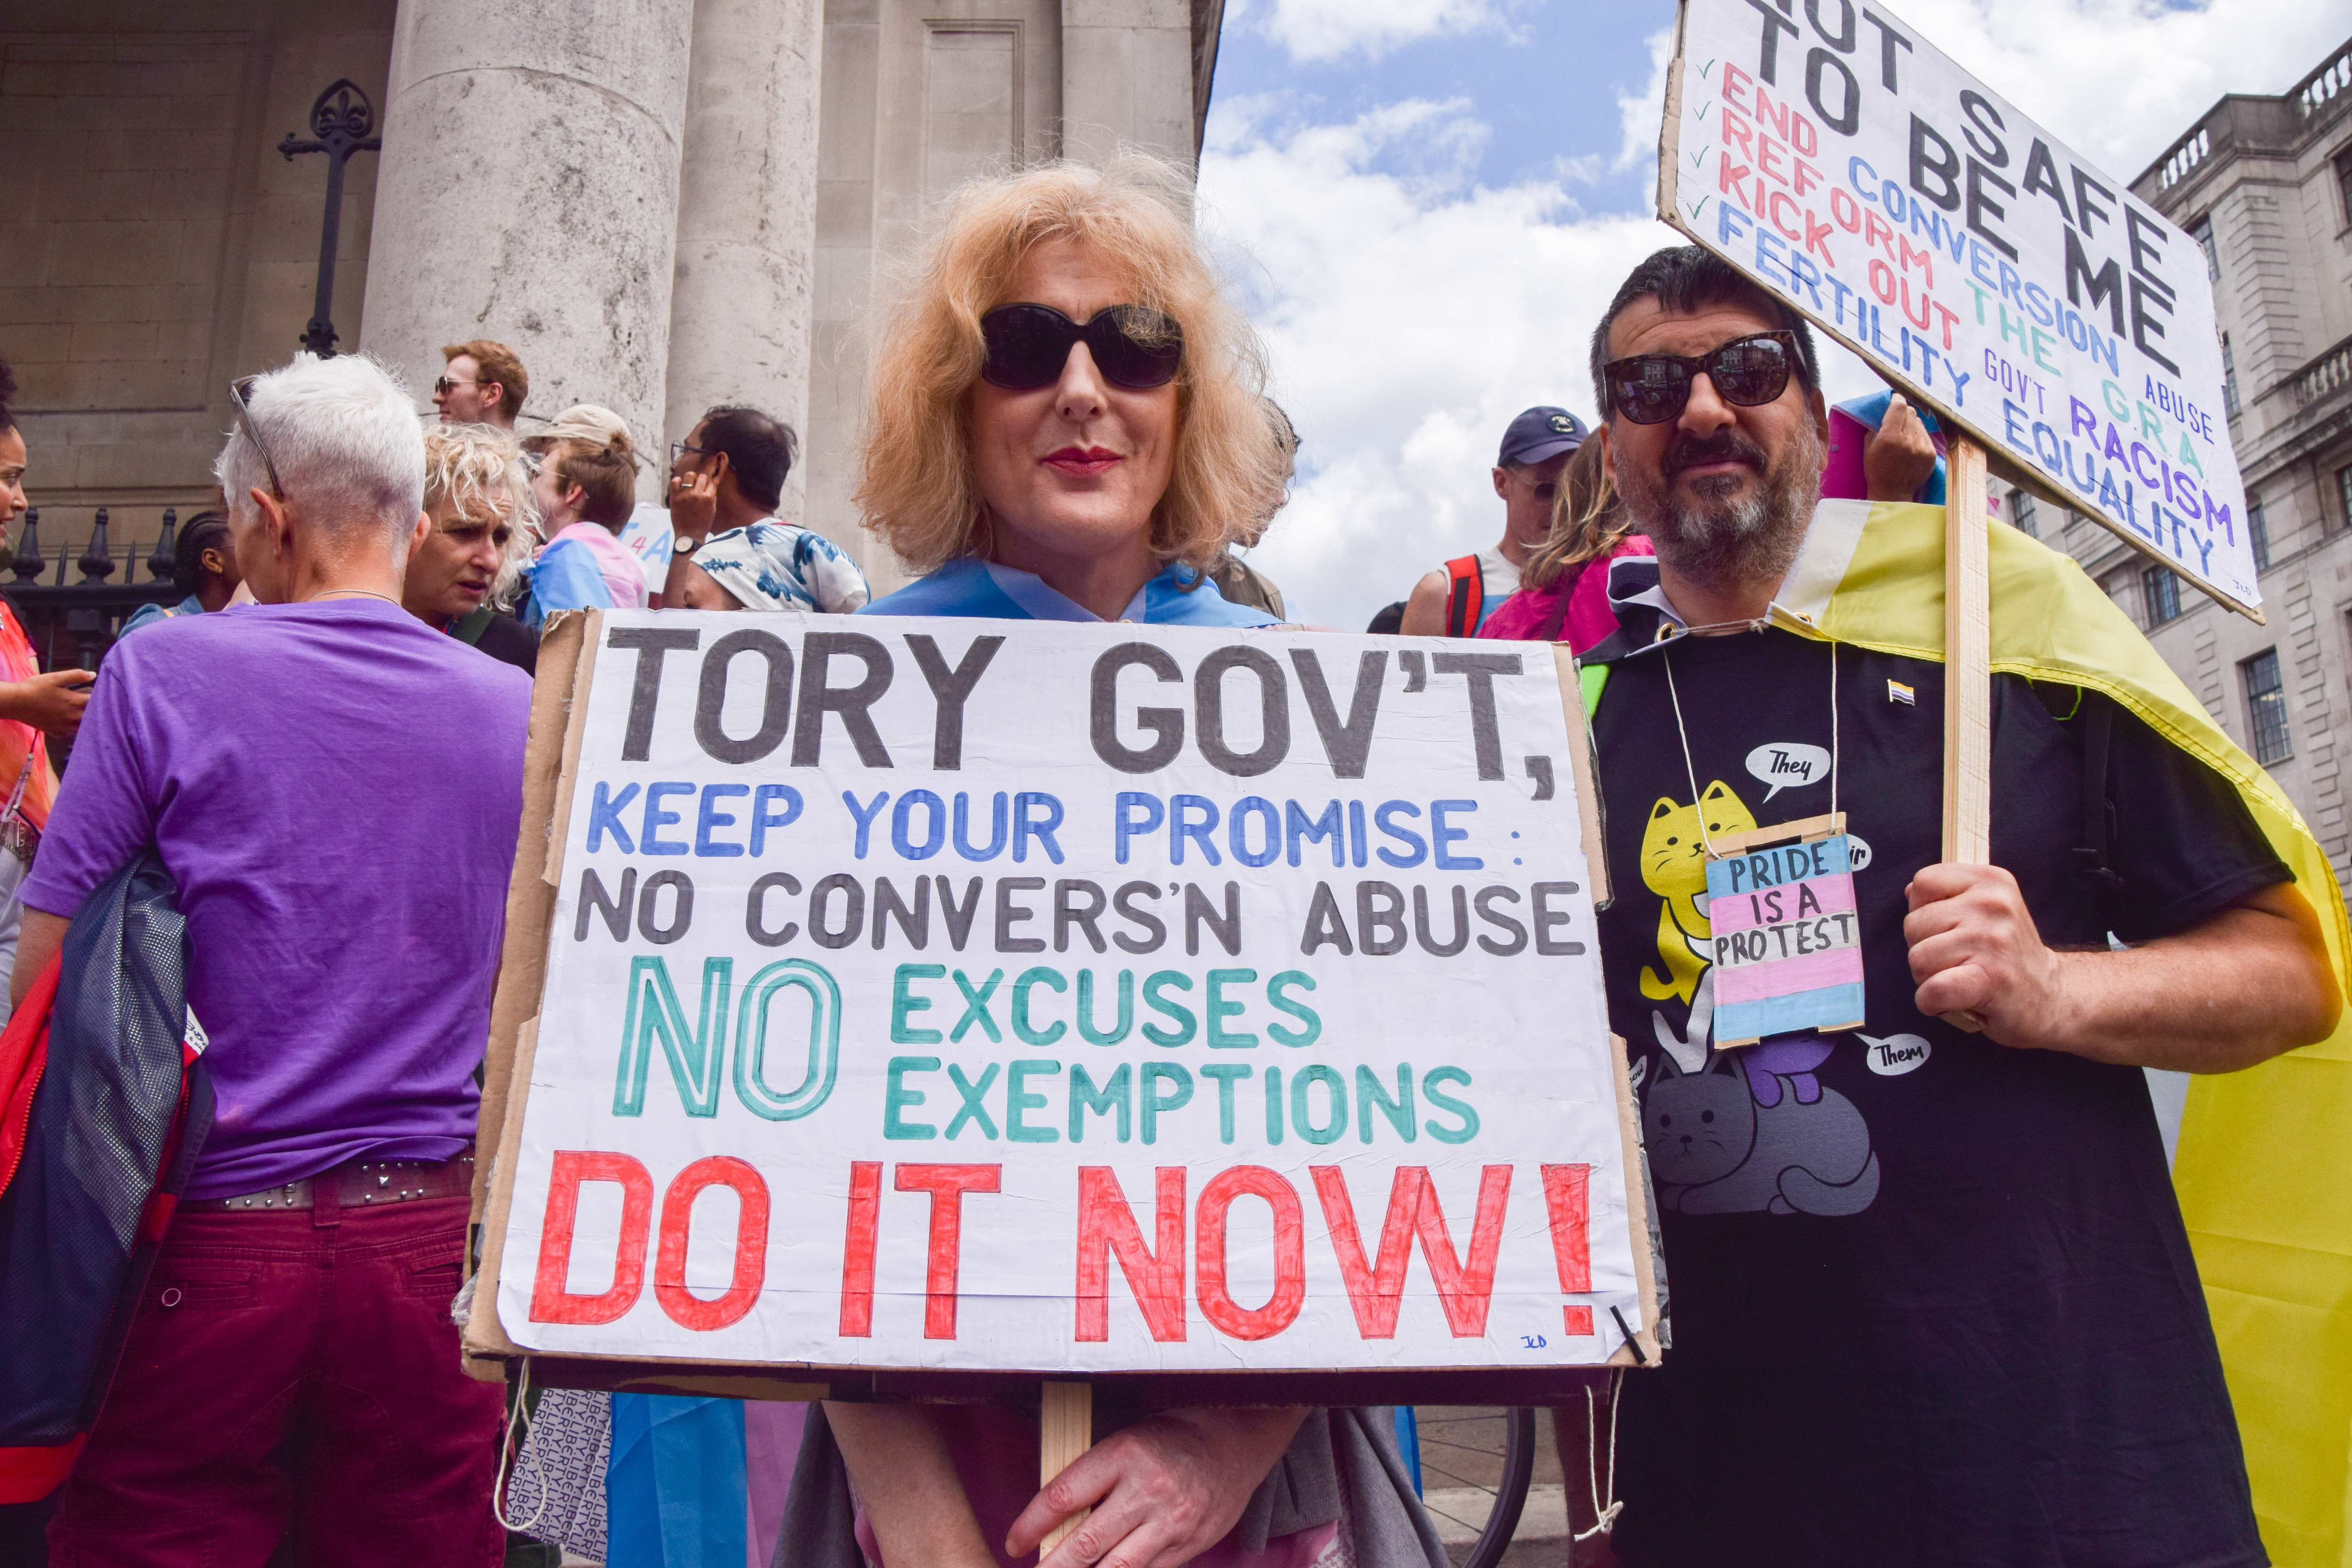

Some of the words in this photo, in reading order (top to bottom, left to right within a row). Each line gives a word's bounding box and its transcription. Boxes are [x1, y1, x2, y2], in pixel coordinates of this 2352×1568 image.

[1747, 0, 1860, 136] TO
[1909, 111, 2018, 264] BE
[2063, 223, 2182, 379] ME
[1775, 0, 1913, 96] OT
[1959, 89, 2177, 302] SAFE
[1722, 107, 1933, 290] REFORM
[1965, 278, 2063, 377] THE
[1722, 62, 1818, 158] END
[1848, 156, 2119, 377] CONVERSION
[2145, 374, 2215, 446] ABUSE
[1717, 200, 1971, 408] FERTILITY
[2002, 398, 2214, 576] EQUALITY
[1719, 151, 1836, 269] KICK
[1868, 259, 1960, 351] OUT
[1984, 348, 2046, 414] GOV'T
[2070, 395, 2234, 547] RACISM
[607, 627, 1007, 771] TORY
[1090, 641, 1554, 801] GOV'T,
[1769, 749, 1812, 780] They
[587, 781, 804, 858] KEEP
[842, 788, 1065, 865] YOUR
[1729, 841, 1829, 893] PRIDE
[1750, 891, 1782, 926] IS
[1798, 883, 1822, 915] A
[574, 867, 694, 945] NO
[746, 872, 1242, 957] CONVERS'N
[1300, 881, 1586, 957] ABUSE
[1716, 913, 1855, 966] PROTEST
[612, 955, 842, 1122] NO
[890, 963, 1322, 1049] EXCUSES
[883, 1056, 1480, 1146] EXEMPTIONS
[1880, 1043, 1925, 1067] Them
[528, 1150, 771, 1332] DO
[839, 1160, 1002, 1340] IT
